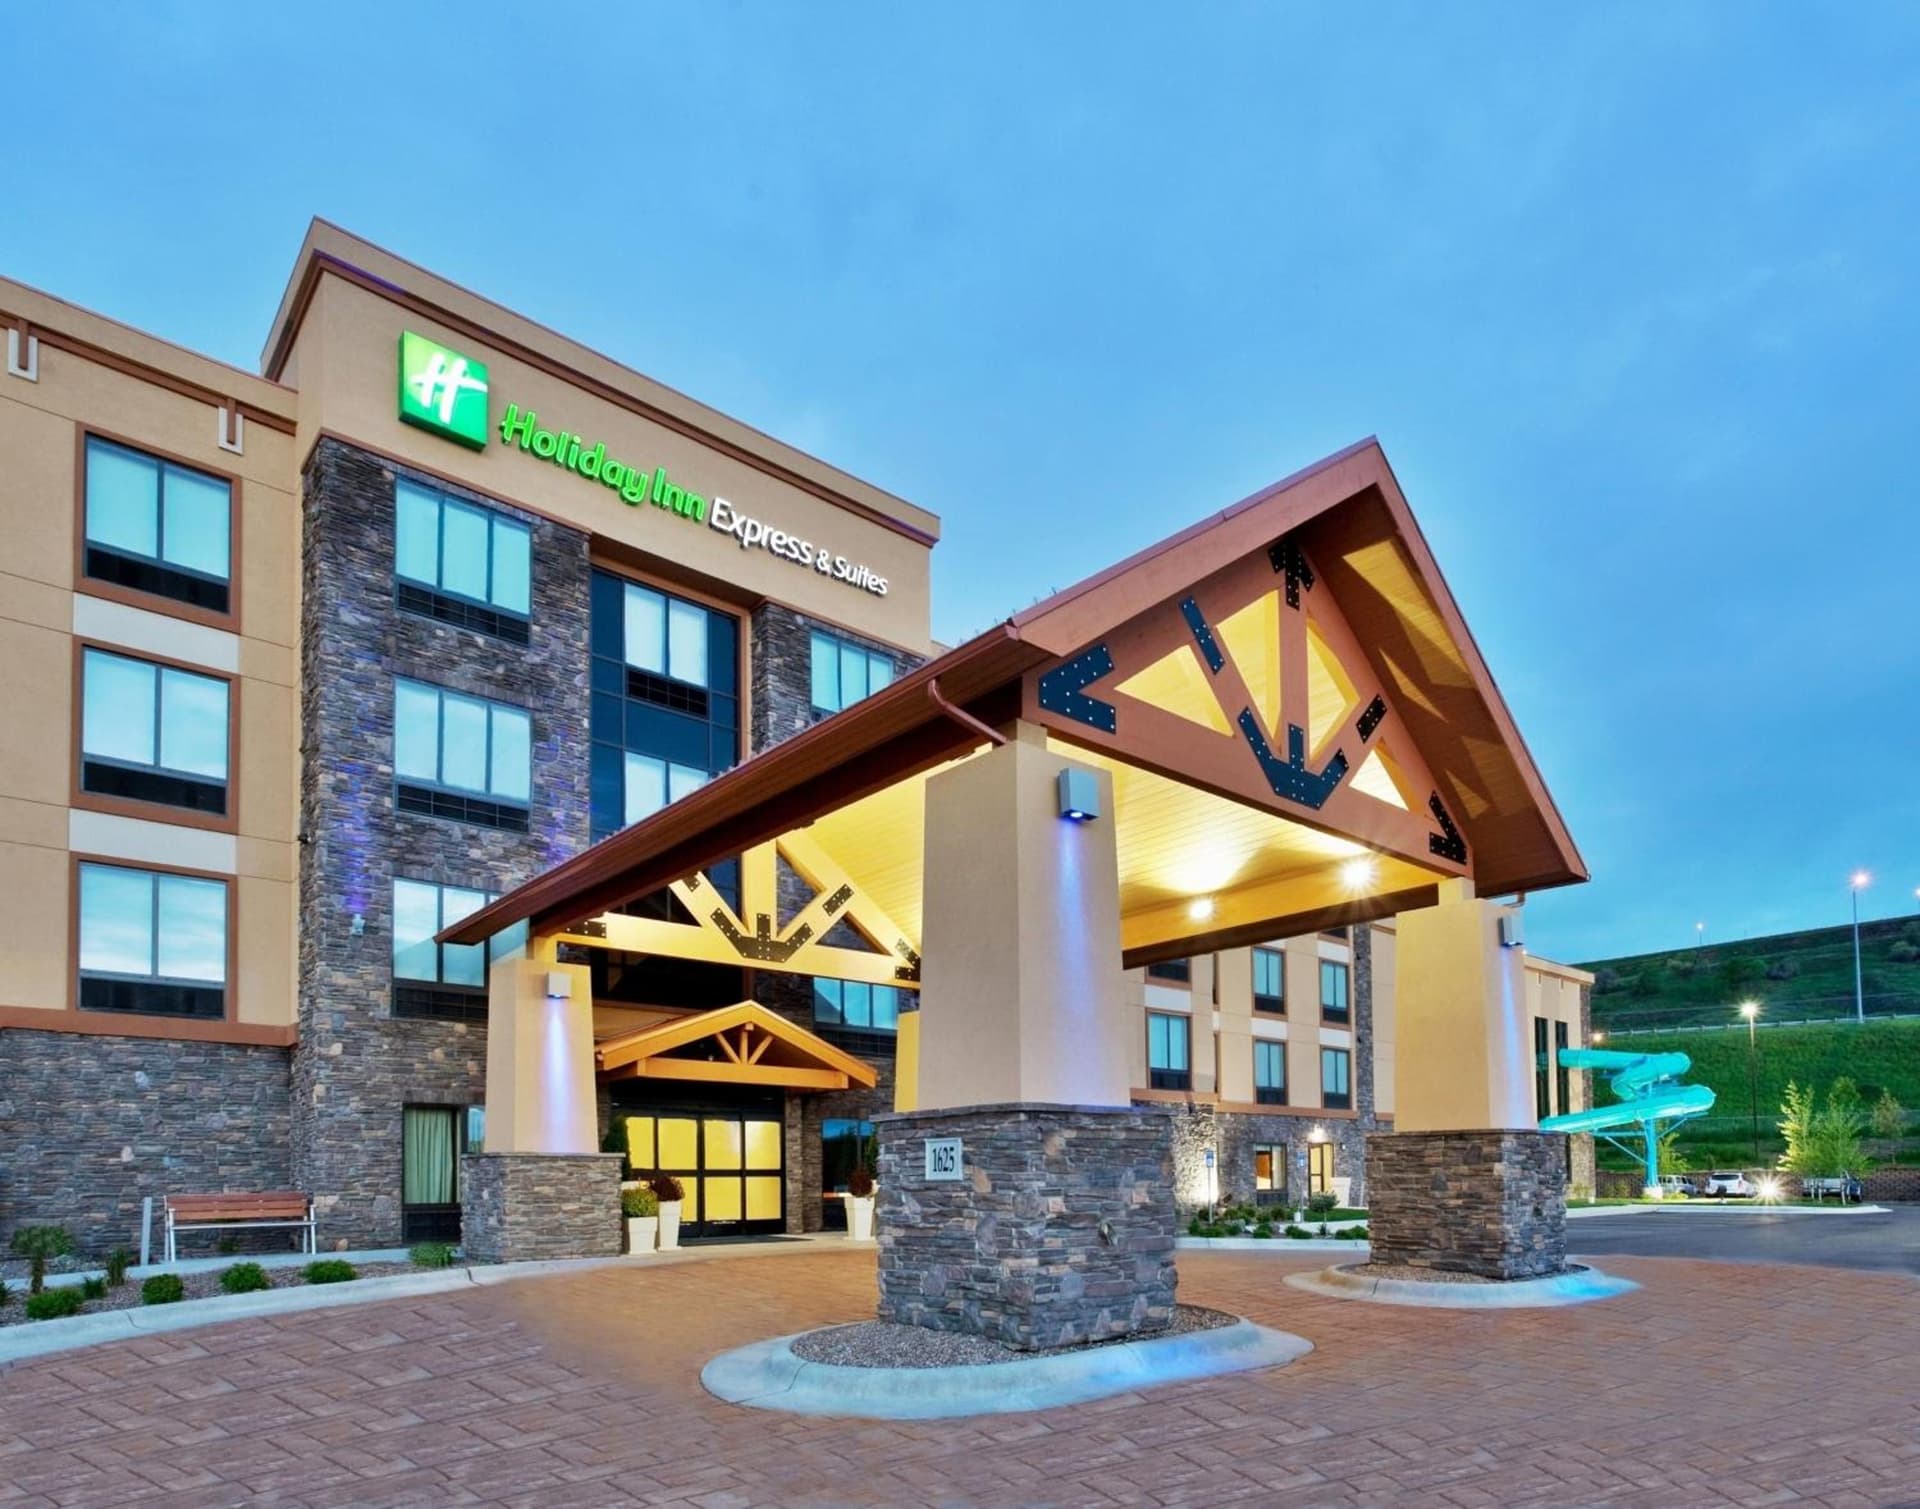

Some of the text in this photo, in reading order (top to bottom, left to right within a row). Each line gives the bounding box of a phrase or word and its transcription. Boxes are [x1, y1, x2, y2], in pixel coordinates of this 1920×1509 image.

[500, 403, 889, 596] Holiday Inn Express & Suites
[932, 1146, 955, 1172] 1625
